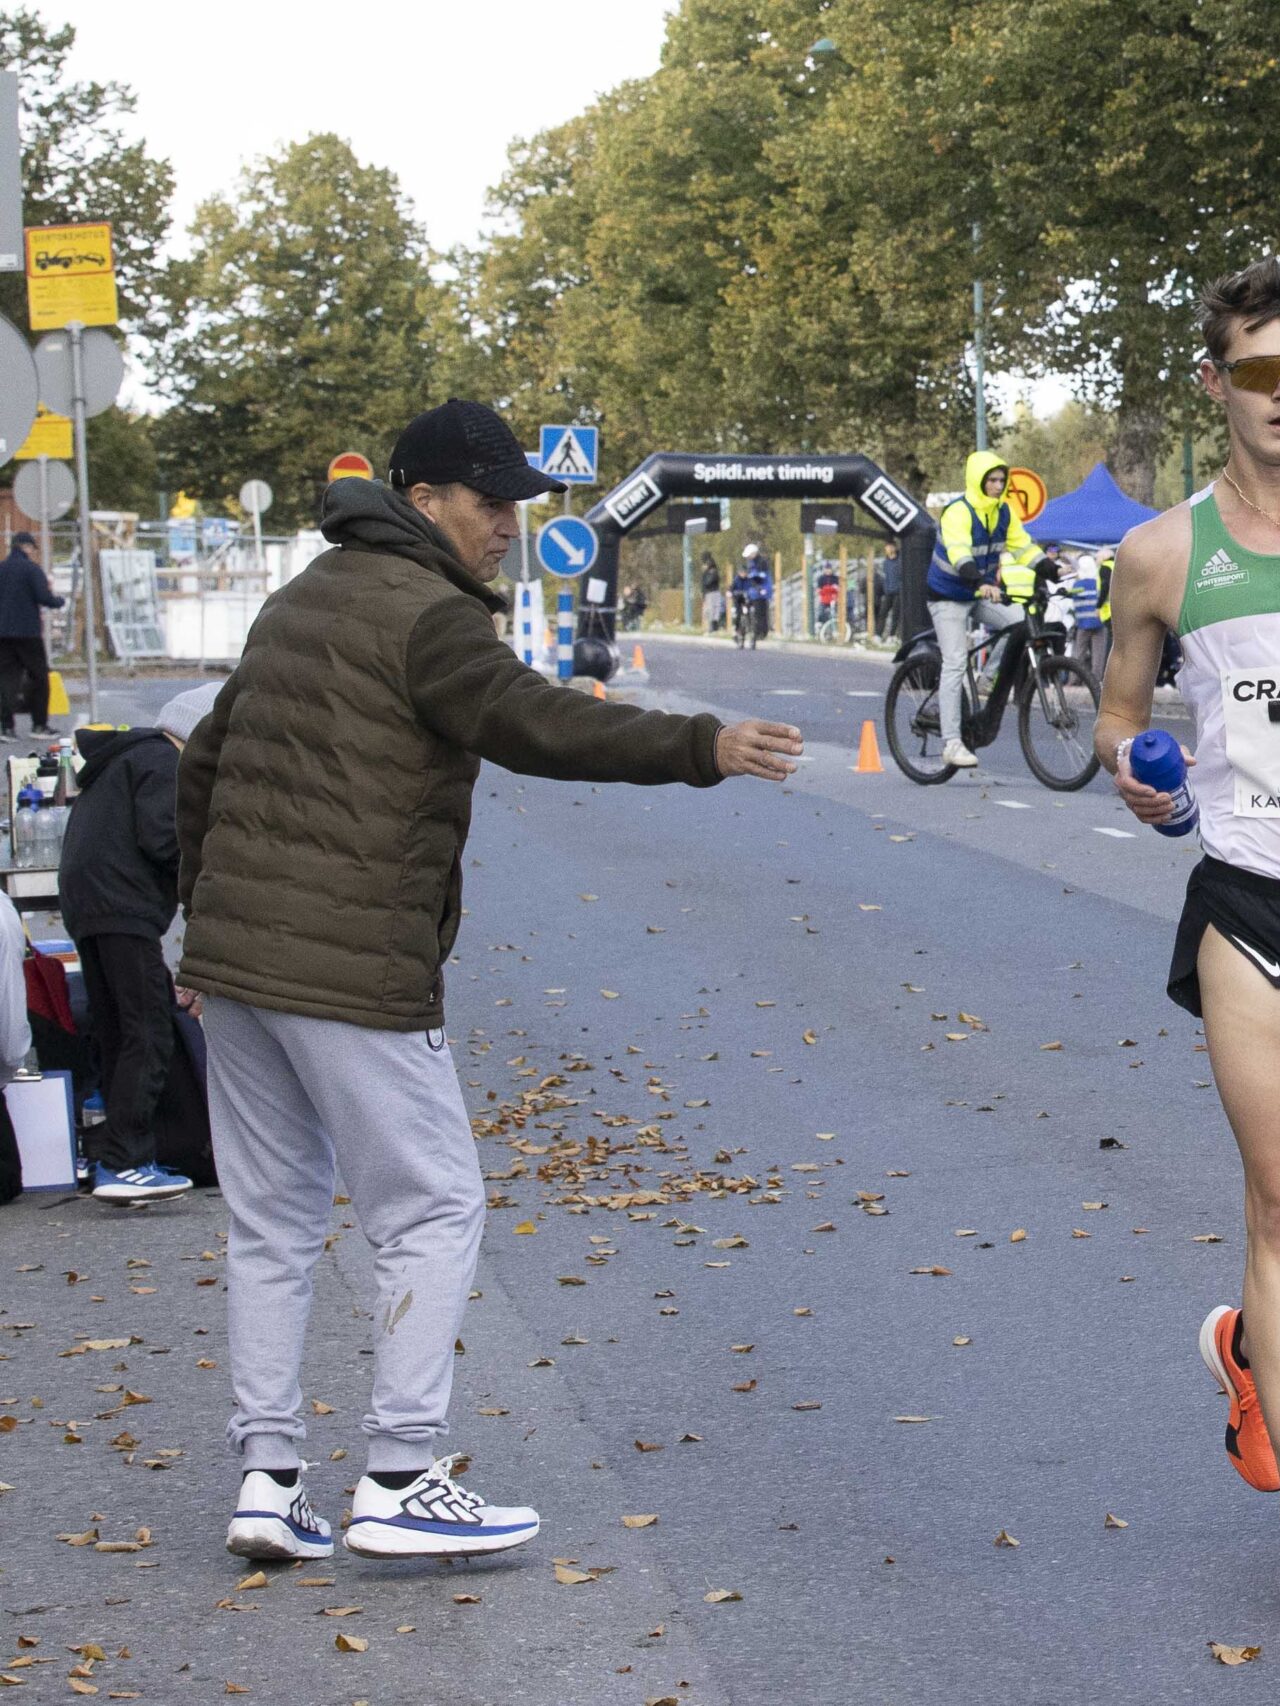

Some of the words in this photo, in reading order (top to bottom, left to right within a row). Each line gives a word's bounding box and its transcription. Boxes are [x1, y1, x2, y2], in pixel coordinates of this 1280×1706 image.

[693, 462, 775, 484] Spiidi.net
[777, 463, 834, 484] timing
[615, 483, 649, 516] START
[873, 489, 907, 519] START
[1201, 562, 1239, 576] adidas
